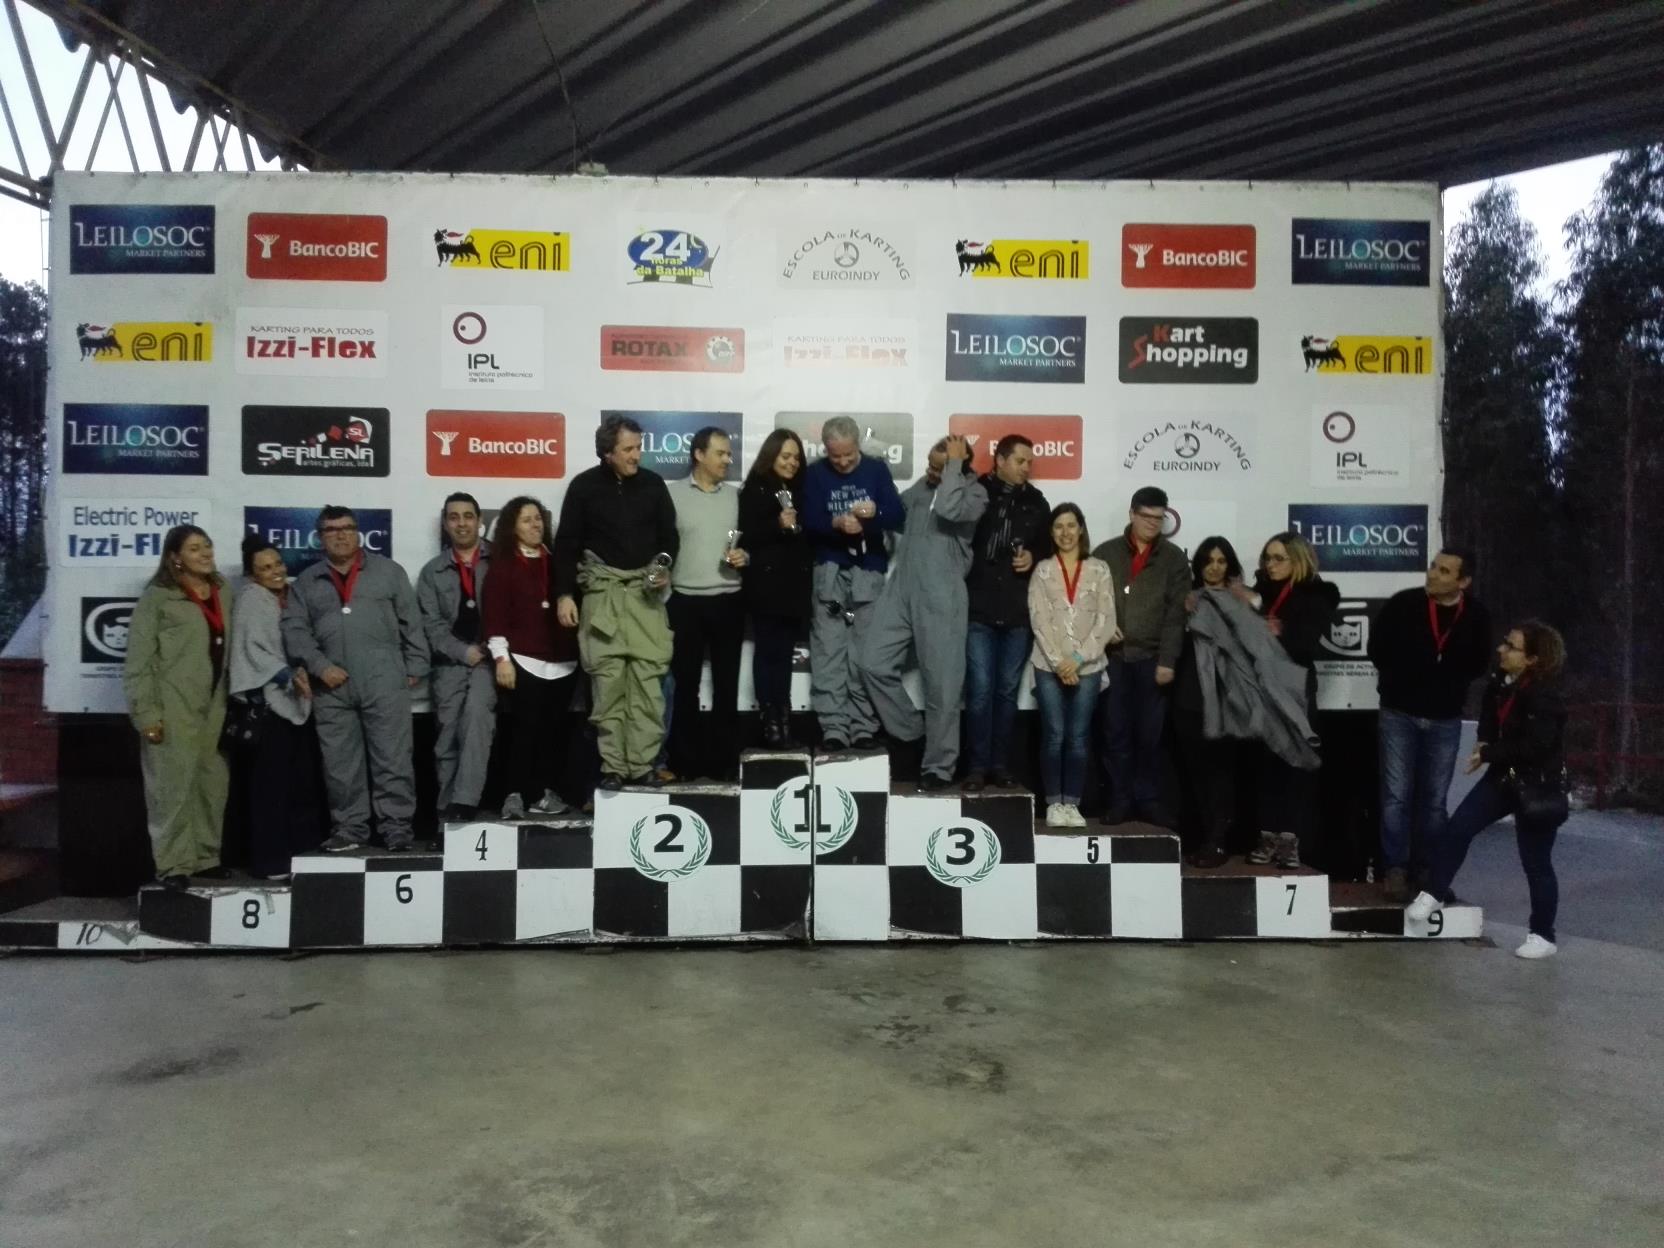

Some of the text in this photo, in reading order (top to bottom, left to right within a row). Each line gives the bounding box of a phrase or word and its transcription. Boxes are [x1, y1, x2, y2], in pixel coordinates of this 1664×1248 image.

[74, 221, 206, 248] LEILOSOC
[639, 231, 691, 262] 24
[126, 249, 206, 258] MARKET PARTNERS
[289, 239, 379, 259] BancoBIC
[489, 231, 561, 271] eni
[782, 230, 835, 279] ESCOLA
[849, 228, 911, 281] KARTING
[1009, 240, 1079, 279] eni
[1162, 249, 1248, 267] BancoBIC
[1296, 234, 1421, 262] LEILOSOC
[636, 265, 705, 277] da Batalha
[812, 270, 880, 281] EUROINDY
[1344, 262, 1422, 271] MARKET PARTNERS
[130, 321, 204, 362] eni
[250, 325, 375, 336] KARTING PARA TODOS
[1153, 323, 1205, 343] Kart
[246, 336, 377, 359] Izzi-Flex
[611, 340, 688, 357] ROTAX
[951, 330, 1077, 357] LEILOSOC
[1128, 334, 1248, 369] Shopping
[1354, 336, 1423, 374] eni
[467, 353, 500, 369] IPL
[999, 358, 1076, 368] MARKET PARTNERS
[67, 421, 200, 447] LEILOSOC
[468, 437, 558, 456] BancoBIC
[1123, 421, 1175, 470] ESCOLA
[1190, 420, 1251, 471] KARTING
[118, 449, 200, 459] MARKET PARTNERS
[655, 455, 689, 464] MARKET
[1153, 460, 1221, 472] EUROINDY
[1336, 451, 1368, 468] IPL
[73, 506, 199, 526] Electric Power
[68, 533, 161, 557] Izzi-Fl
[1342, 547, 1419, 557] MARKET PARTNERS
[793, 784, 832, 833] 1
[474, 829, 489, 861] 4
[653, 813, 685, 853] 2
[945, 827, 976, 866] 3
[1087, 836, 1100, 864] 5
[395, 873, 414, 904] 6
[1285, 883, 1297, 916] 7
[241, 899, 261, 930] 8
[1427, 909, 1444, 937] 9
[75, 922, 101, 945] 10
